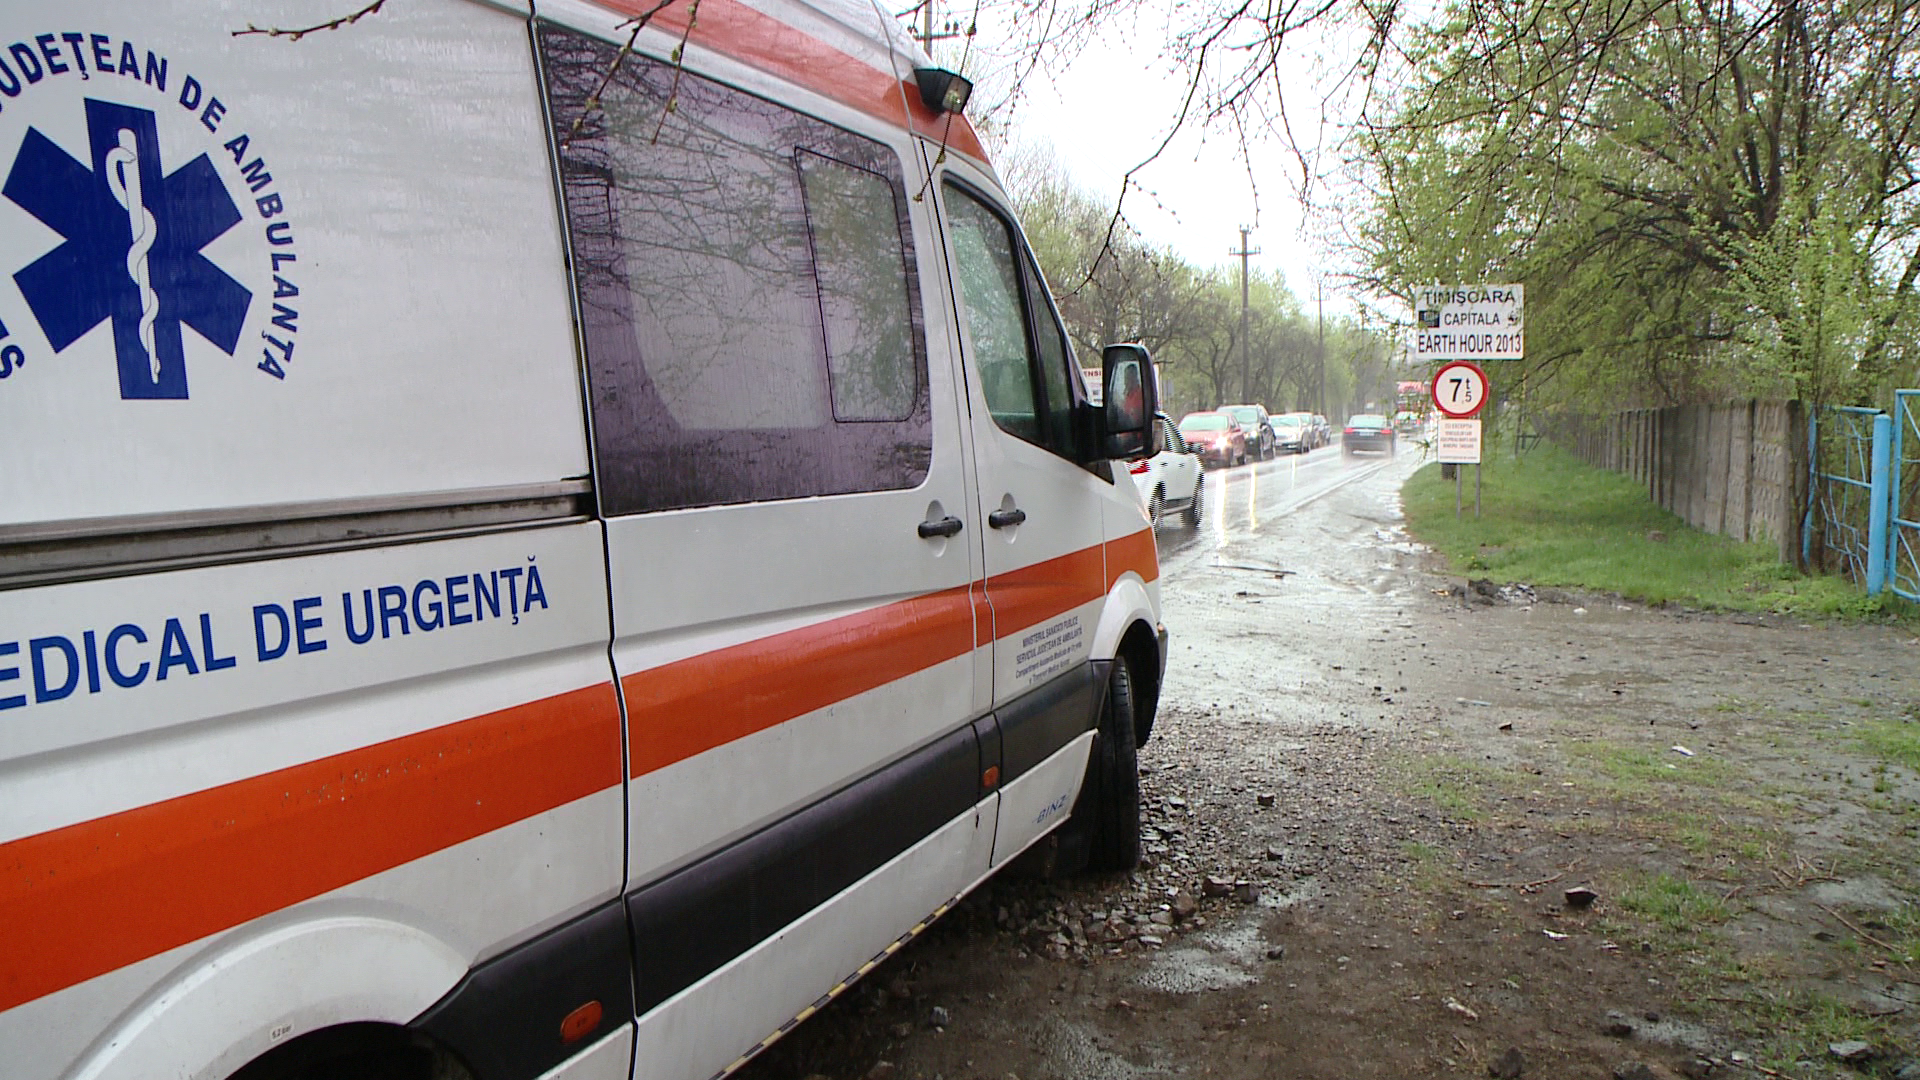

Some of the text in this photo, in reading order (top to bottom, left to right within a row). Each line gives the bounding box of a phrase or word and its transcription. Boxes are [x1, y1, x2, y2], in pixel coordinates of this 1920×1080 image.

[0, 32, 168, 114] UDEŢEAN
[179, 74, 227, 133] DE
[1444, 312, 1501, 326] CAPITALA
[1418, 334, 1521, 353] EARTH HOUR 2013
[252, 597, 327, 662] DE
